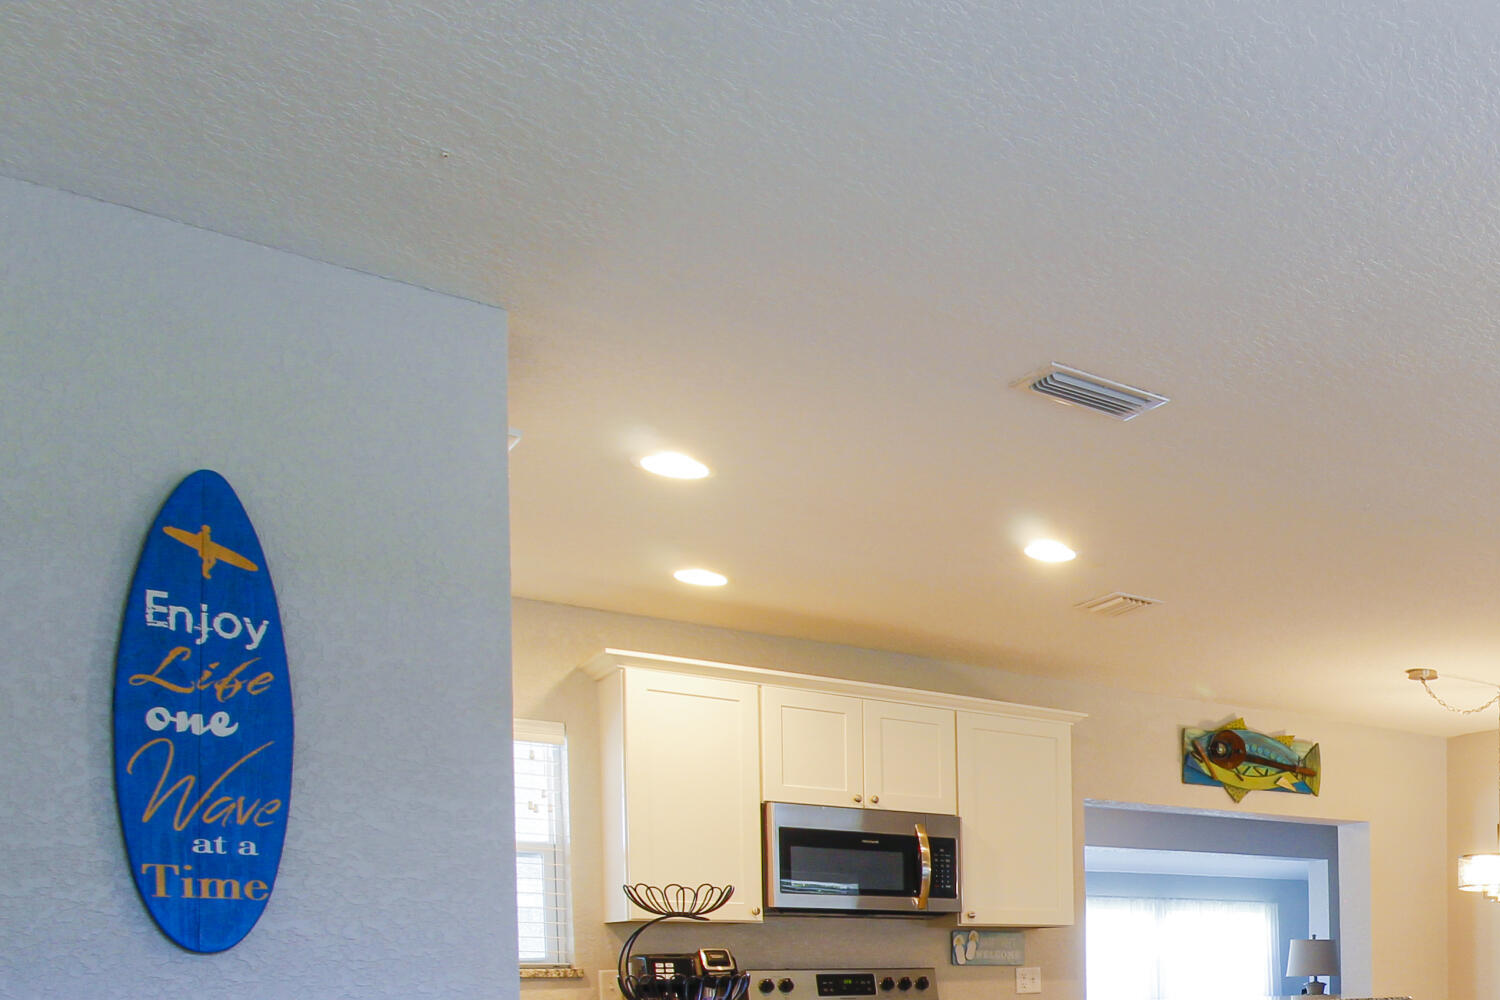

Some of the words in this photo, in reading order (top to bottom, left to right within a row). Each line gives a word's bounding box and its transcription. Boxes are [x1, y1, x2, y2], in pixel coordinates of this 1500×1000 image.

[144, 588, 270, 651] Enjoy
[127, 645, 275, 703] Life
[144, 705, 240, 738] one
[126, 737, 282, 832] Wave
[191, 835, 228, 855] at
[237, 839, 260, 856] a
[140, 862, 270, 902] Time
